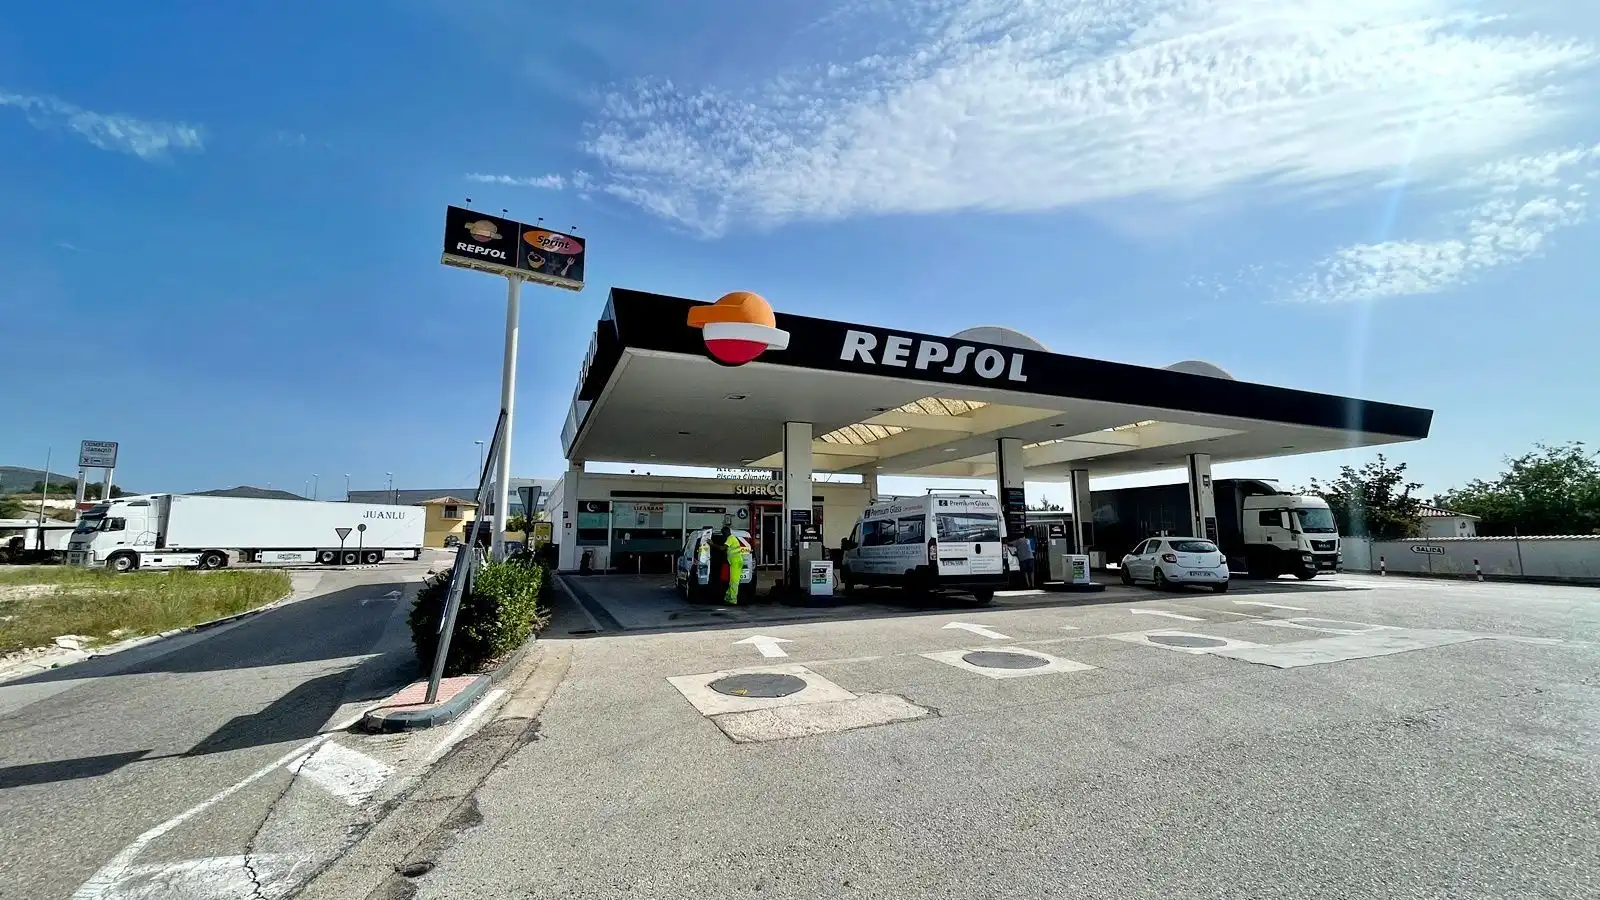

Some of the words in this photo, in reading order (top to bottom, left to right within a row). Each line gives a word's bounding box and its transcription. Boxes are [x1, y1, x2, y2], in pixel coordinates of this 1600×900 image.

[537, 235, 570, 249] Sprint
[456, 241, 507, 260] REPSOL
[839, 329, 1028, 382] REPSOL
[362, 510, 406, 519] JUANLU
[1416, 546, 1442, 554] SALIDA
